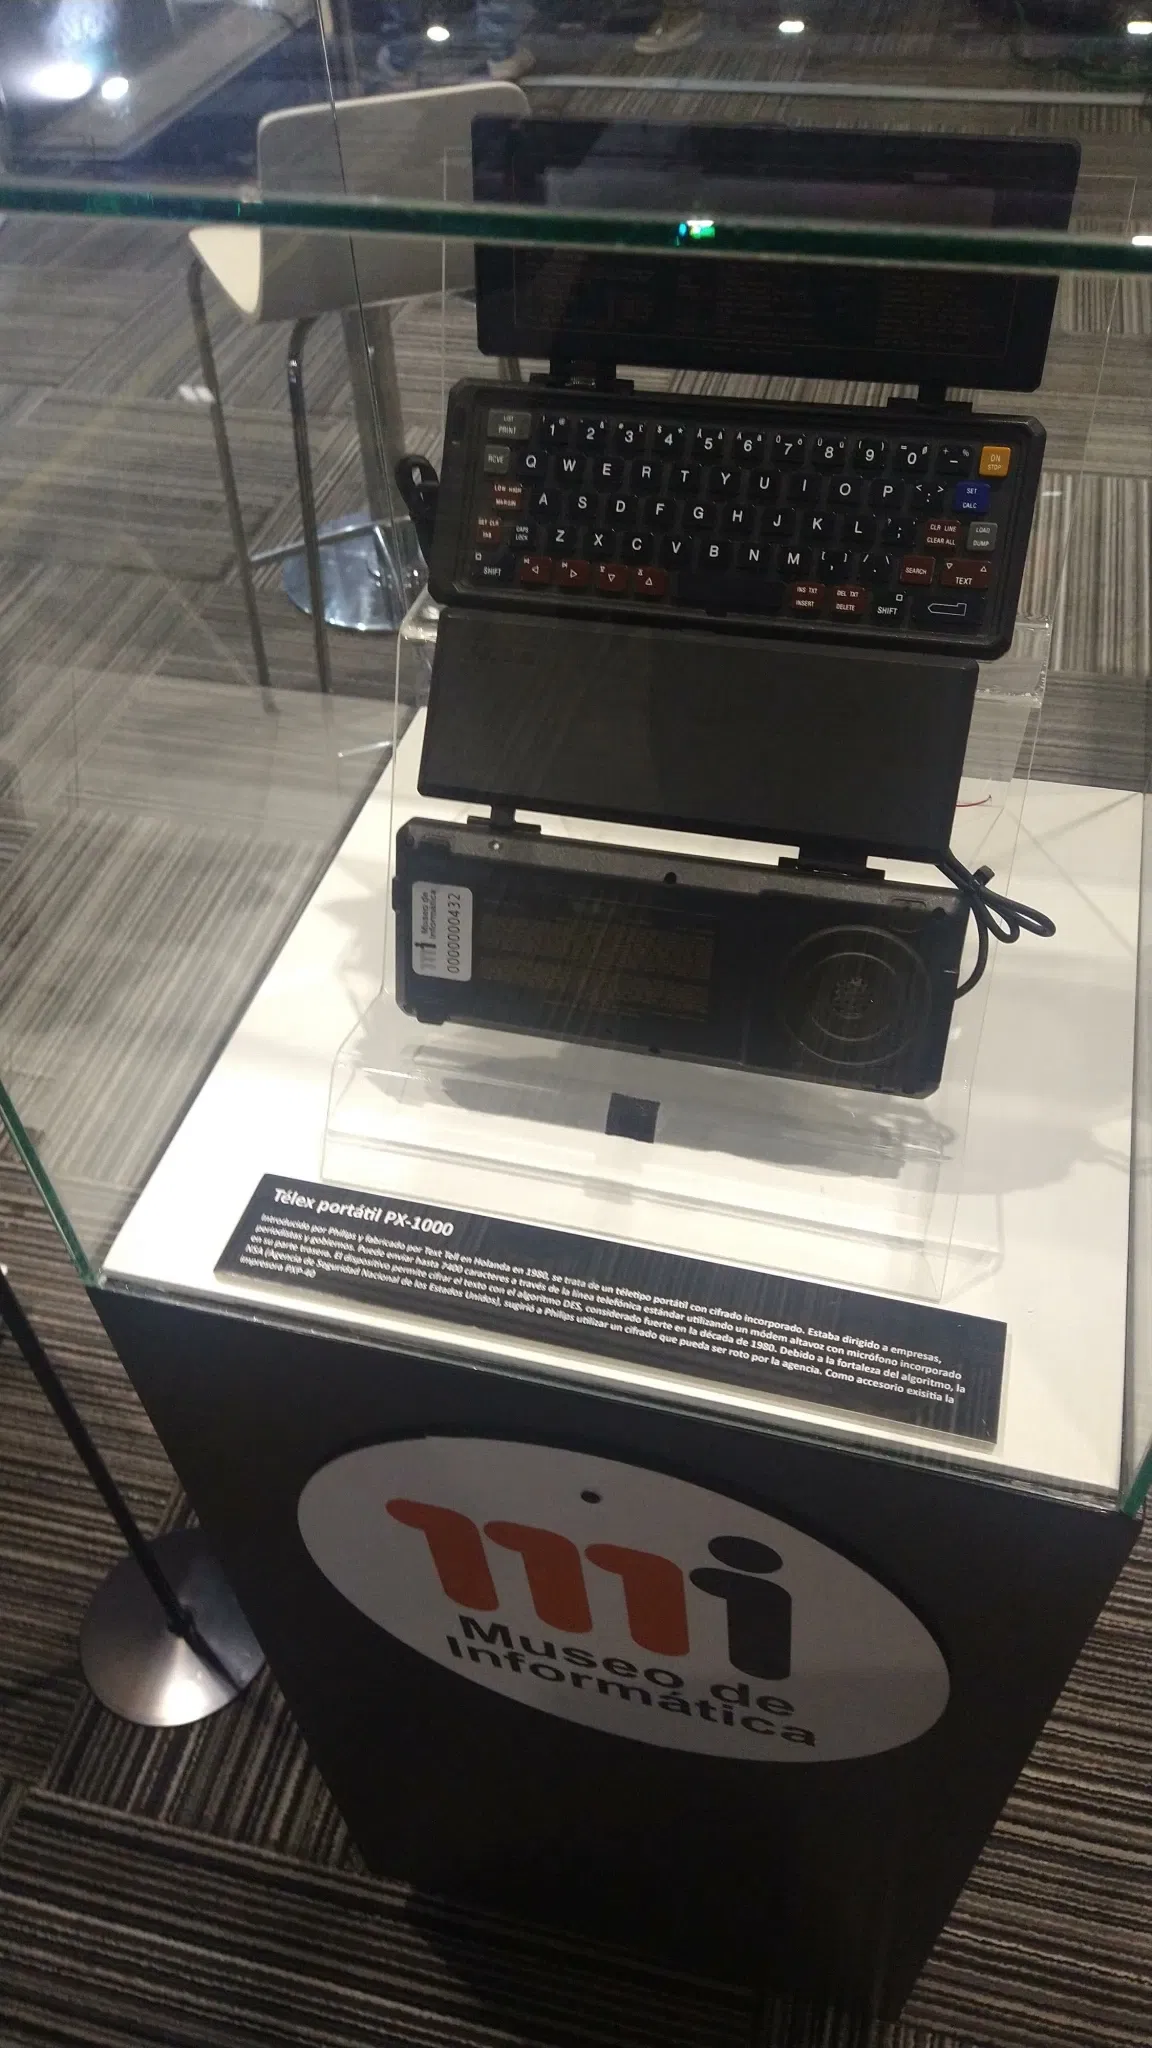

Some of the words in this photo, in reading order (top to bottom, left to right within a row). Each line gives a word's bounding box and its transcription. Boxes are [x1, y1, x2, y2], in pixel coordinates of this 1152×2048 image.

[550, 424, 555, 436] 1
[586, 427, 595, 440] 2
[624, 430, 634, 443] 3
[664, 433, 673, 445] 4
[704, 437, 713, 450] 5
[743, 439, 753, 452] 6
[784, 443, 793, 455] 7
[824, 446, 834, 459] 8
[865, 449, 875, 462] 9
[990, 454, 1001, 462] ON
[525, 455, 537, 468] Q
[563, 459, 577, 472] W
[602, 463, 612, 475] E
[641, 466, 652, 478] R
[680, 470, 690, 482] T
[720, 473, 731, 485] Y
[759, 477, 770, 490] U
[802, 479, 807, 491] I
[839, 483, 851, 496] O
[882, 485, 893, 497] P
[538, 493, 548, 505] A
[578, 496, 587, 509] S
[616, 500, 626, 513] D
[655, 503, 665, 515] F
[693, 507, 704, 519] G
[732, 510, 743, 522] H
[773, 515, 782, 527] J
[812, 517, 823, 530] K
[854, 521, 863, 534] L
[975, 526, 990, 534] LOAD
[556, 530, 565, 542] Z
[593, 533, 604, 547] X
[631, 538, 642, 551] C
[671, 541, 682, 554] V
[709, 545, 719, 557] B
[749, 549, 760, 561] N
[787, 553, 800, 565] M
[483, 567, 501, 575] SHIFT
[905, 566, 927, 575] SEARCH
[955, 577, 972, 585] TEXT
[836, 603, 855, 612] DELETE
[877, 606, 897, 615] SHIFT
[447, 892, 461, 974] 0000000432
[274, 1188, 315, 1208] Télex
[316, 1200, 382, 1221] portátil
[384, 1211, 453, 1236] PX-1000
[459, 1256, 472, 1264] en
[473, 1257, 510, 1272] Holanda
[511, 1266, 524, 1274] en
[525, 1268, 549, 1280] 1980,
[551, 1274, 563, 1283] se
[564, 1276, 586, 1287] trata
[587, 1281, 600, 1290] de
[601, 1285, 614, 1293] un
[652, 1296, 688, 1309] portátil
[689, 1304, 707, 1313] con
[708, 1307, 742, 1320] cifrado
[744, 1314, 804, 1333] incorporado.
[807, 1327, 840, 1341] Estaba
[842, 1335, 880, 1349] dirigido
[881, 1344, 888, 1352] a
[890, 1347, 941, 1364] empresas,
[464, 1268, 509, 1283] caracteres
[510, 1277, 517, 1285] a
[518, 1278, 546, 1291] través
[547, 1284, 560, 1294] de
[561, 1286, 570, 1296] la
[571, 1289, 594, 1301] línea
[596, 1295, 641, 1311] telefónica
[643, 1306, 685, 1320] estándar
[686, 1315, 733, 1330] utilizando
[735, 1326, 748, 1334] un
[750, 1329, 787, 1342] módem
[789, 1336, 824, 1350] altavoz
[826, 1345, 844, 1354] con
[846, 1349, 898, 1366] micrófono
[900, 1359, 962, 1379] incorporado
[452, 1276, 463, 1285] el
[463, 1278, 487, 1290] texto
[488, 1285, 505, 1294] con
[506, 1287, 516, 1296] el
[516, 1290, 561, 1306] algoritmo
[562, 1299, 583, 1312] DES,
[585, 1306, 641, 1323] considerado
[643, 1316, 673, 1330] fuerte
[674, 1325, 687, 1333] en
[688, 1326, 698, 1335] la
[699, 1329, 734, 1343] década
[735, 1337, 749, 1346] de
[750, 1340, 777, 1352] 1980.
[779, 1346, 815, 1360] Debido
[825, 1355, 835, 1365] la
[837, 1358, 881, 1375] fortaleza
[883, 1368, 899, 1379] del
[901, 1373, 953, 1391] algoritmo,
[956, 1383, 965, 1393] la
[464, 1290, 501, 1306] Unidos),
[544, 1307, 574, 1321] Philips
[576, 1316, 609, 1328] utilizar
[609, 1323, 623, 1331] un
[624, 1326, 657, 1339] cifrado
[658, 1334, 678, 1344] que
[678, 1338, 710, 1350] pueda
[711, 1345, 727, 1354] ser
[728, 1349, 750, 1359] roto
[750, 1354, 769, 1363] por
[770, 1356, 780, 1366] la
[781, 1360, 822, 1375] agencia.
[824, 1368, 854, 1382] Como
[856, 1377, 904, 1392] accesorio
[945, 1394, 954, 1404] la
[458, 1615, 685, 1689] Museo
[709, 1681, 796, 1717] de
[446, 1635, 817, 1747] Informática
